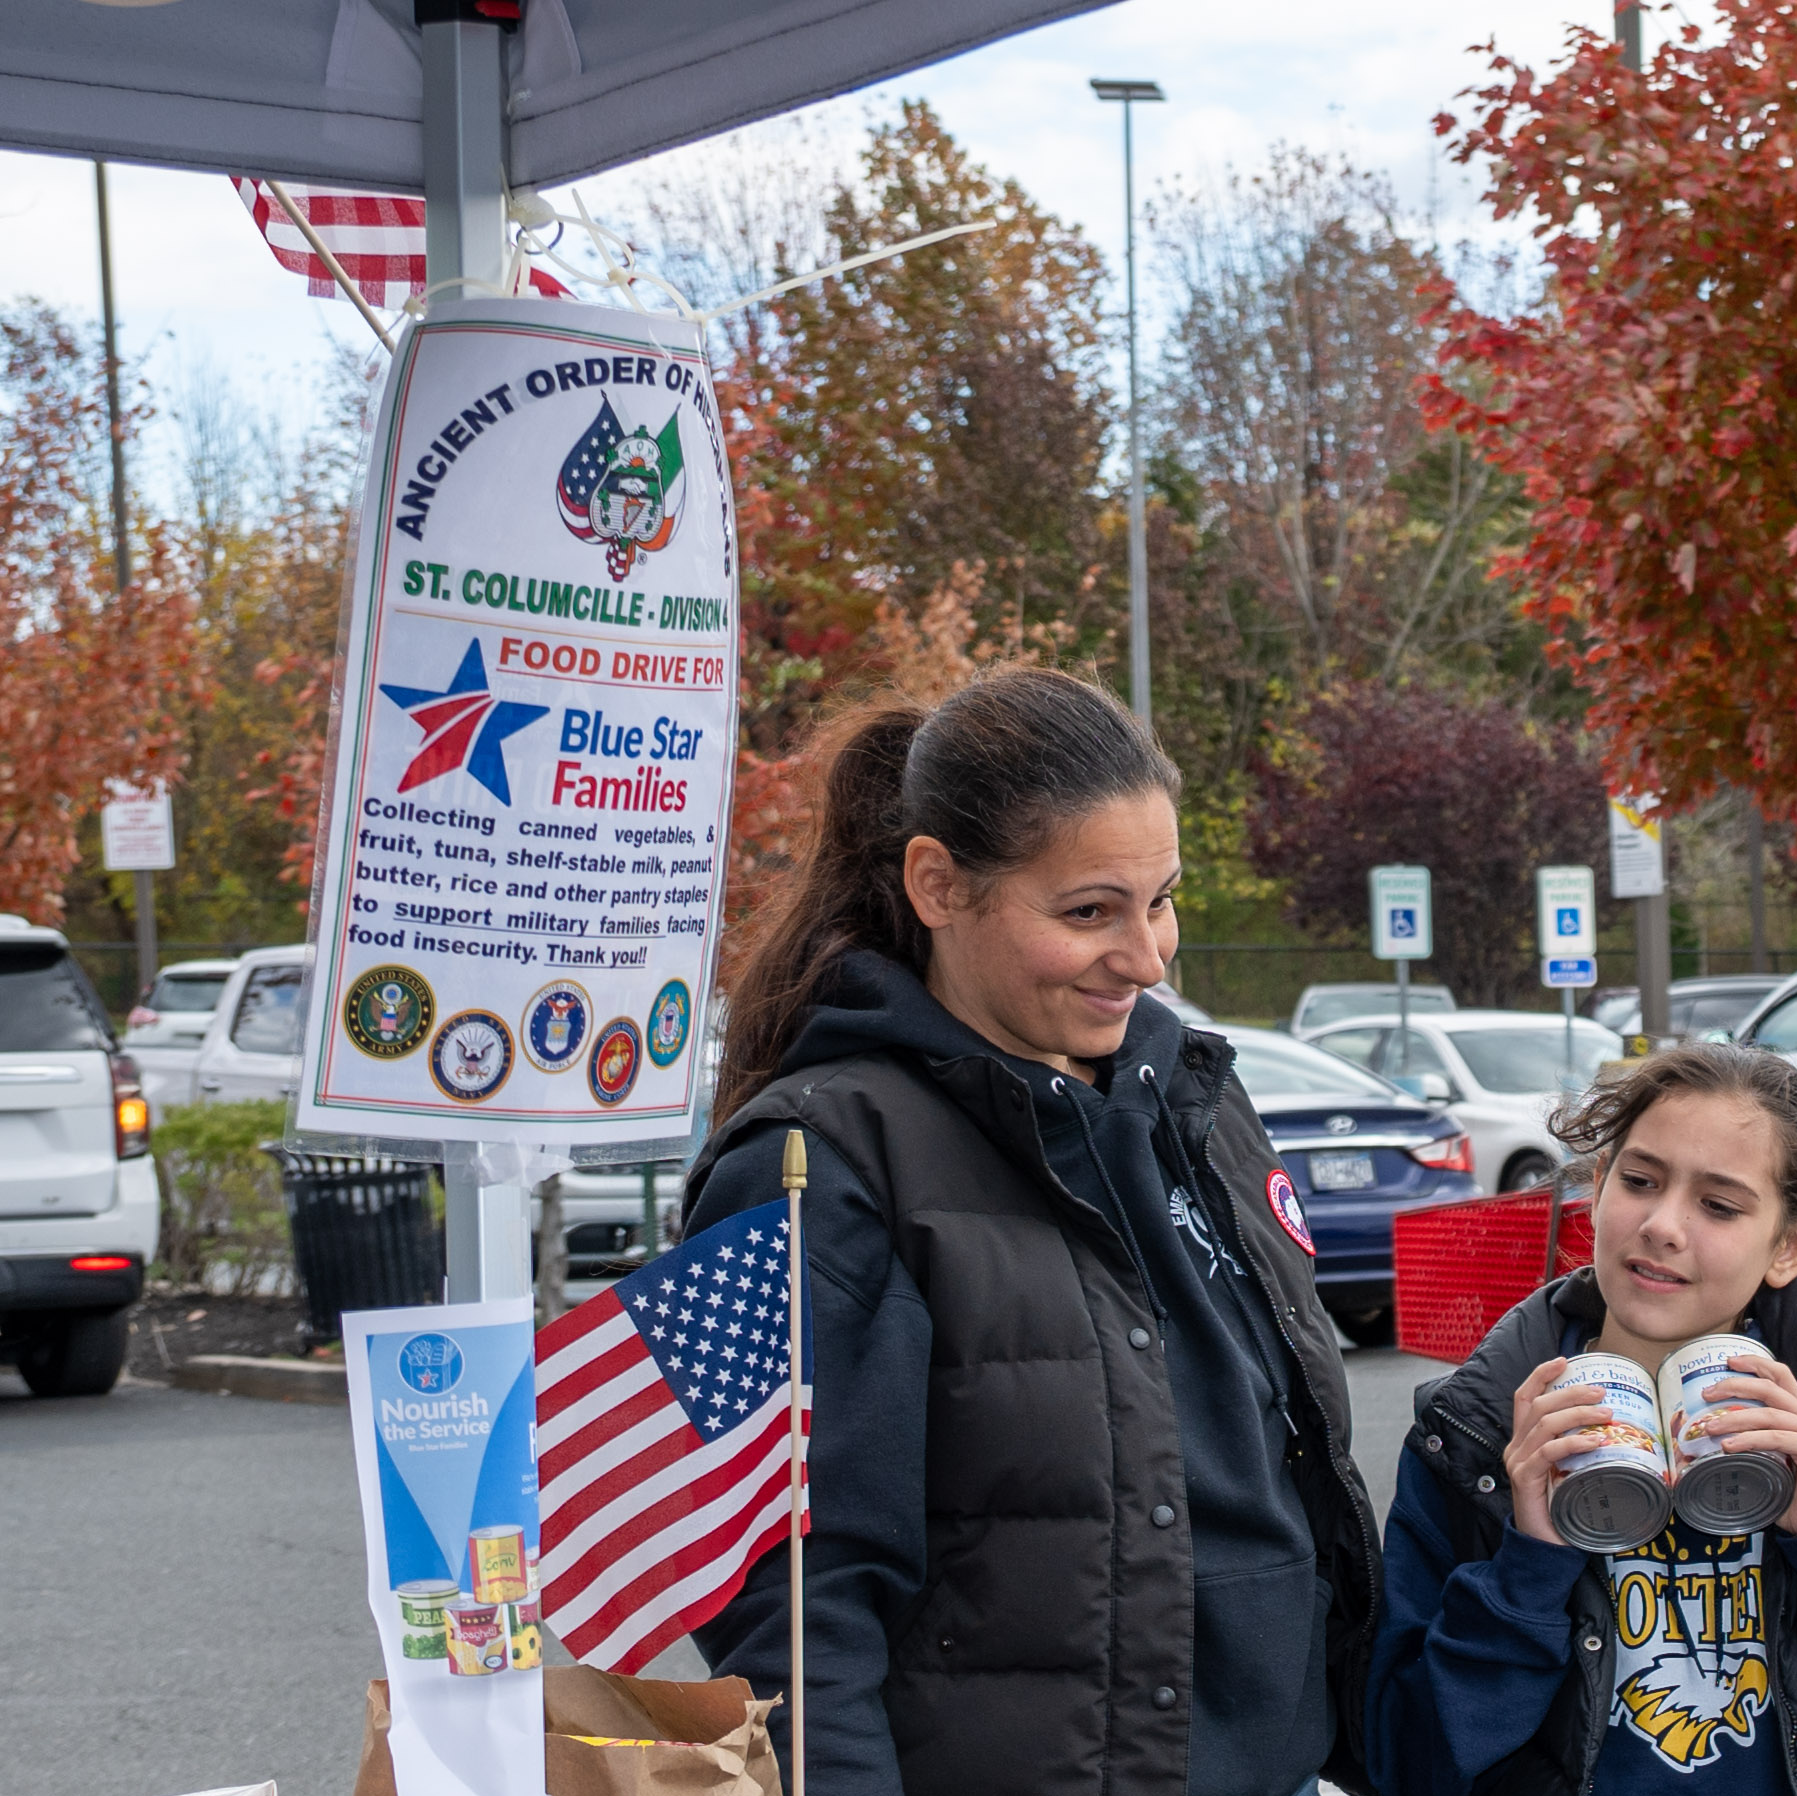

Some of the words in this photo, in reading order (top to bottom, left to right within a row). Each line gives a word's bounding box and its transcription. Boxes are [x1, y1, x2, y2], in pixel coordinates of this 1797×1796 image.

[395, 383, 517, 542] ANCIENT
[526, 356, 657, 400] ORDER
[665, 363, 693, 395] OF
[402, 560, 452, 600] ST.
[462, 569, 643, 626] COLUMCILLE
[659, 596, 721, 632] DIVISION
[499, 636, 601, 676] FOOD
[611, 652, 687, 685] DRIVE
[692, 657, 725, 686] FOR
[559, 708, 644, 760] Blue
[649, 715, 703, 761] Star
[551, 759, 689, 814] Families
[363, 797, 497, 837] Collecting
[518, 819, 598, 843] canned
[614, 824, 697, 848] vegetables,
[706, 825, 715, 844] &
[358, 829, 424, 861] fruit,
[434, 838, 498, 868] tuna,
[506, 848, 627, 876] shelf-stable
[631, 855, 667, 878] milk,
[670, 856, 713, 880] peanut
[356, 861, 442, 894] butter,
[450, 872, 498, 896] rice
[505, 881, 548, 900] and
[554, 884, 607, 903] other
[610, 887, 661, 909] pantry
[664, 886, 709, 909] staples
[352, 893, 379, 914] to
[395, 901, 494, 929] support
[506, 913, 590, 936] military
[599, 915, 661, 935] families
[666, 915, 706, 937] facing
[347, 924, 405, 949] food
[413, 931, 539, 963] insecurity.
[546, 944, 606, 965] Thank
[611, 947, 648, 968] you!!
[367, 1042, 404, 1054] ARMY
[381, 1391, 489, 1423] Nourish
[384, 1423, 417, 1441] the
[420, 1418, 491, 1439] Service
[1612, 1566, 1766, 1645] OTTE
